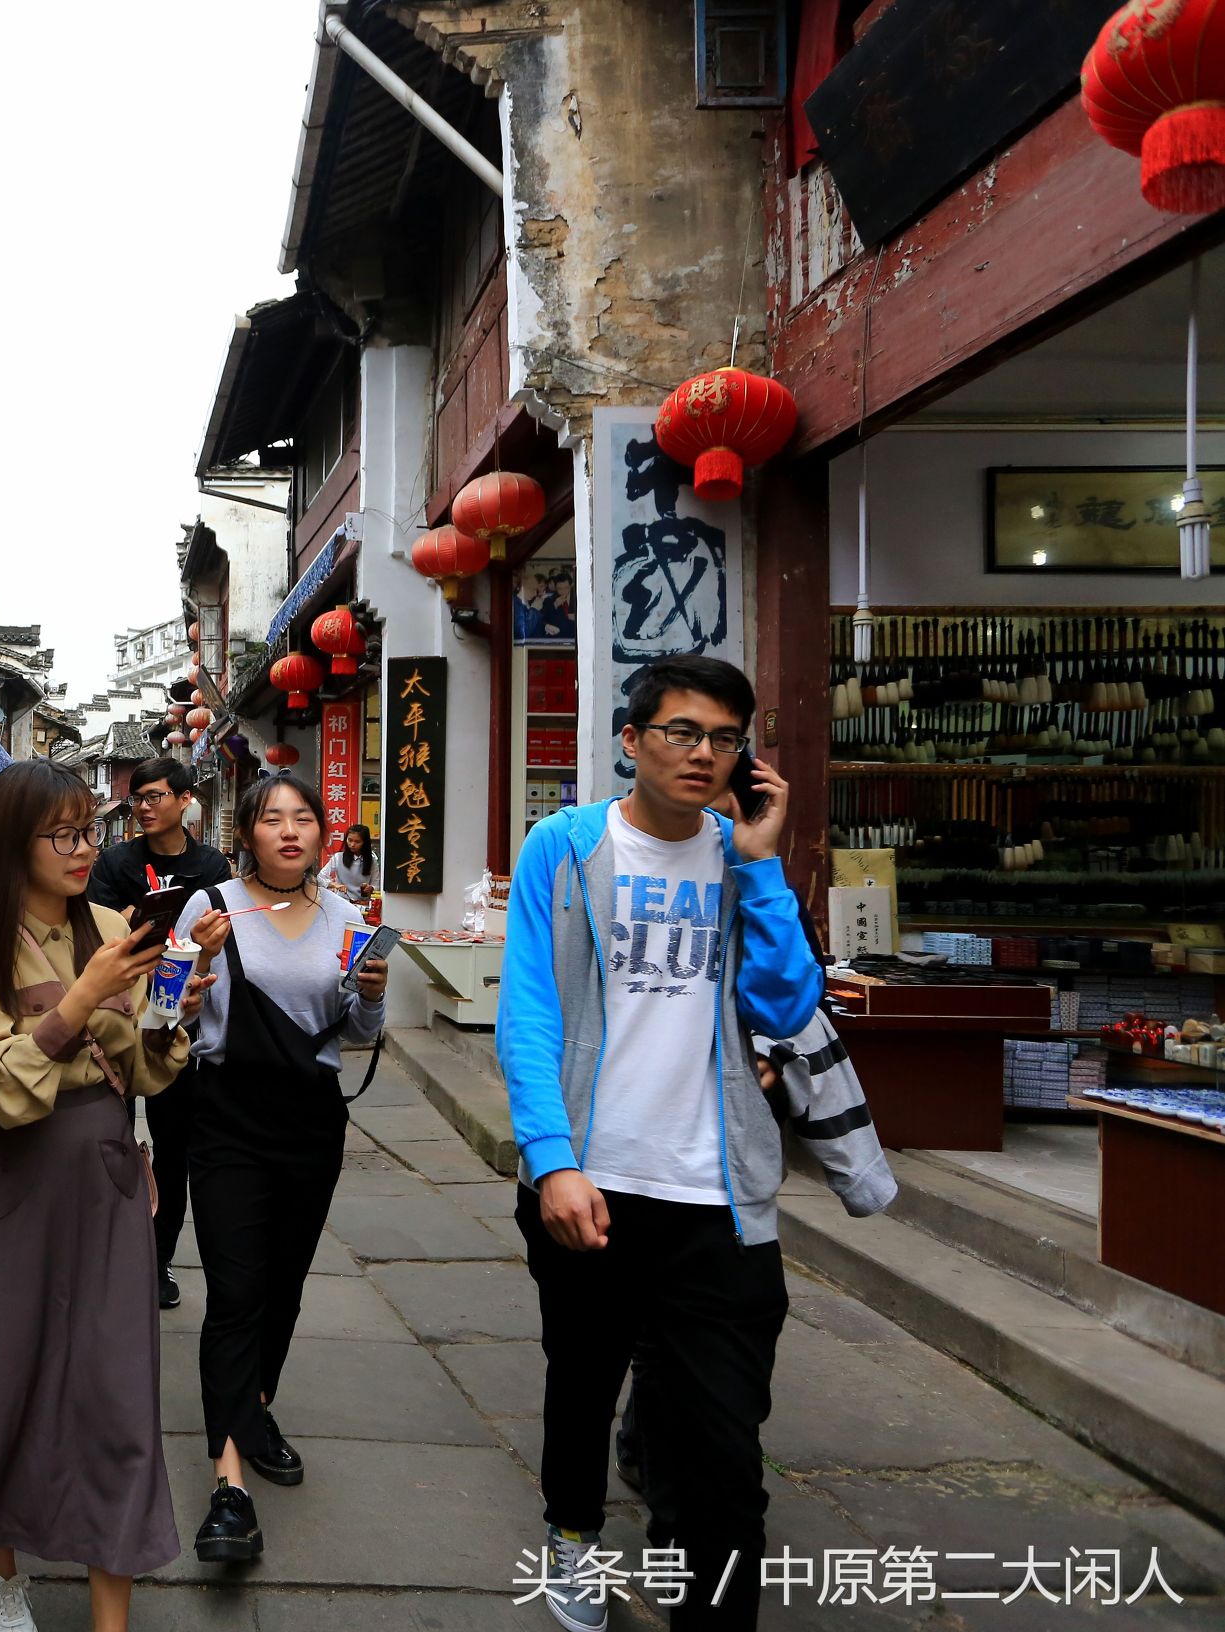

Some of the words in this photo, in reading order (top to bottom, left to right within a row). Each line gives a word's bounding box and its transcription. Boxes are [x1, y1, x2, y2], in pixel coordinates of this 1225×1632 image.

[326, 714, 348, 859] 祁门红茶农户
